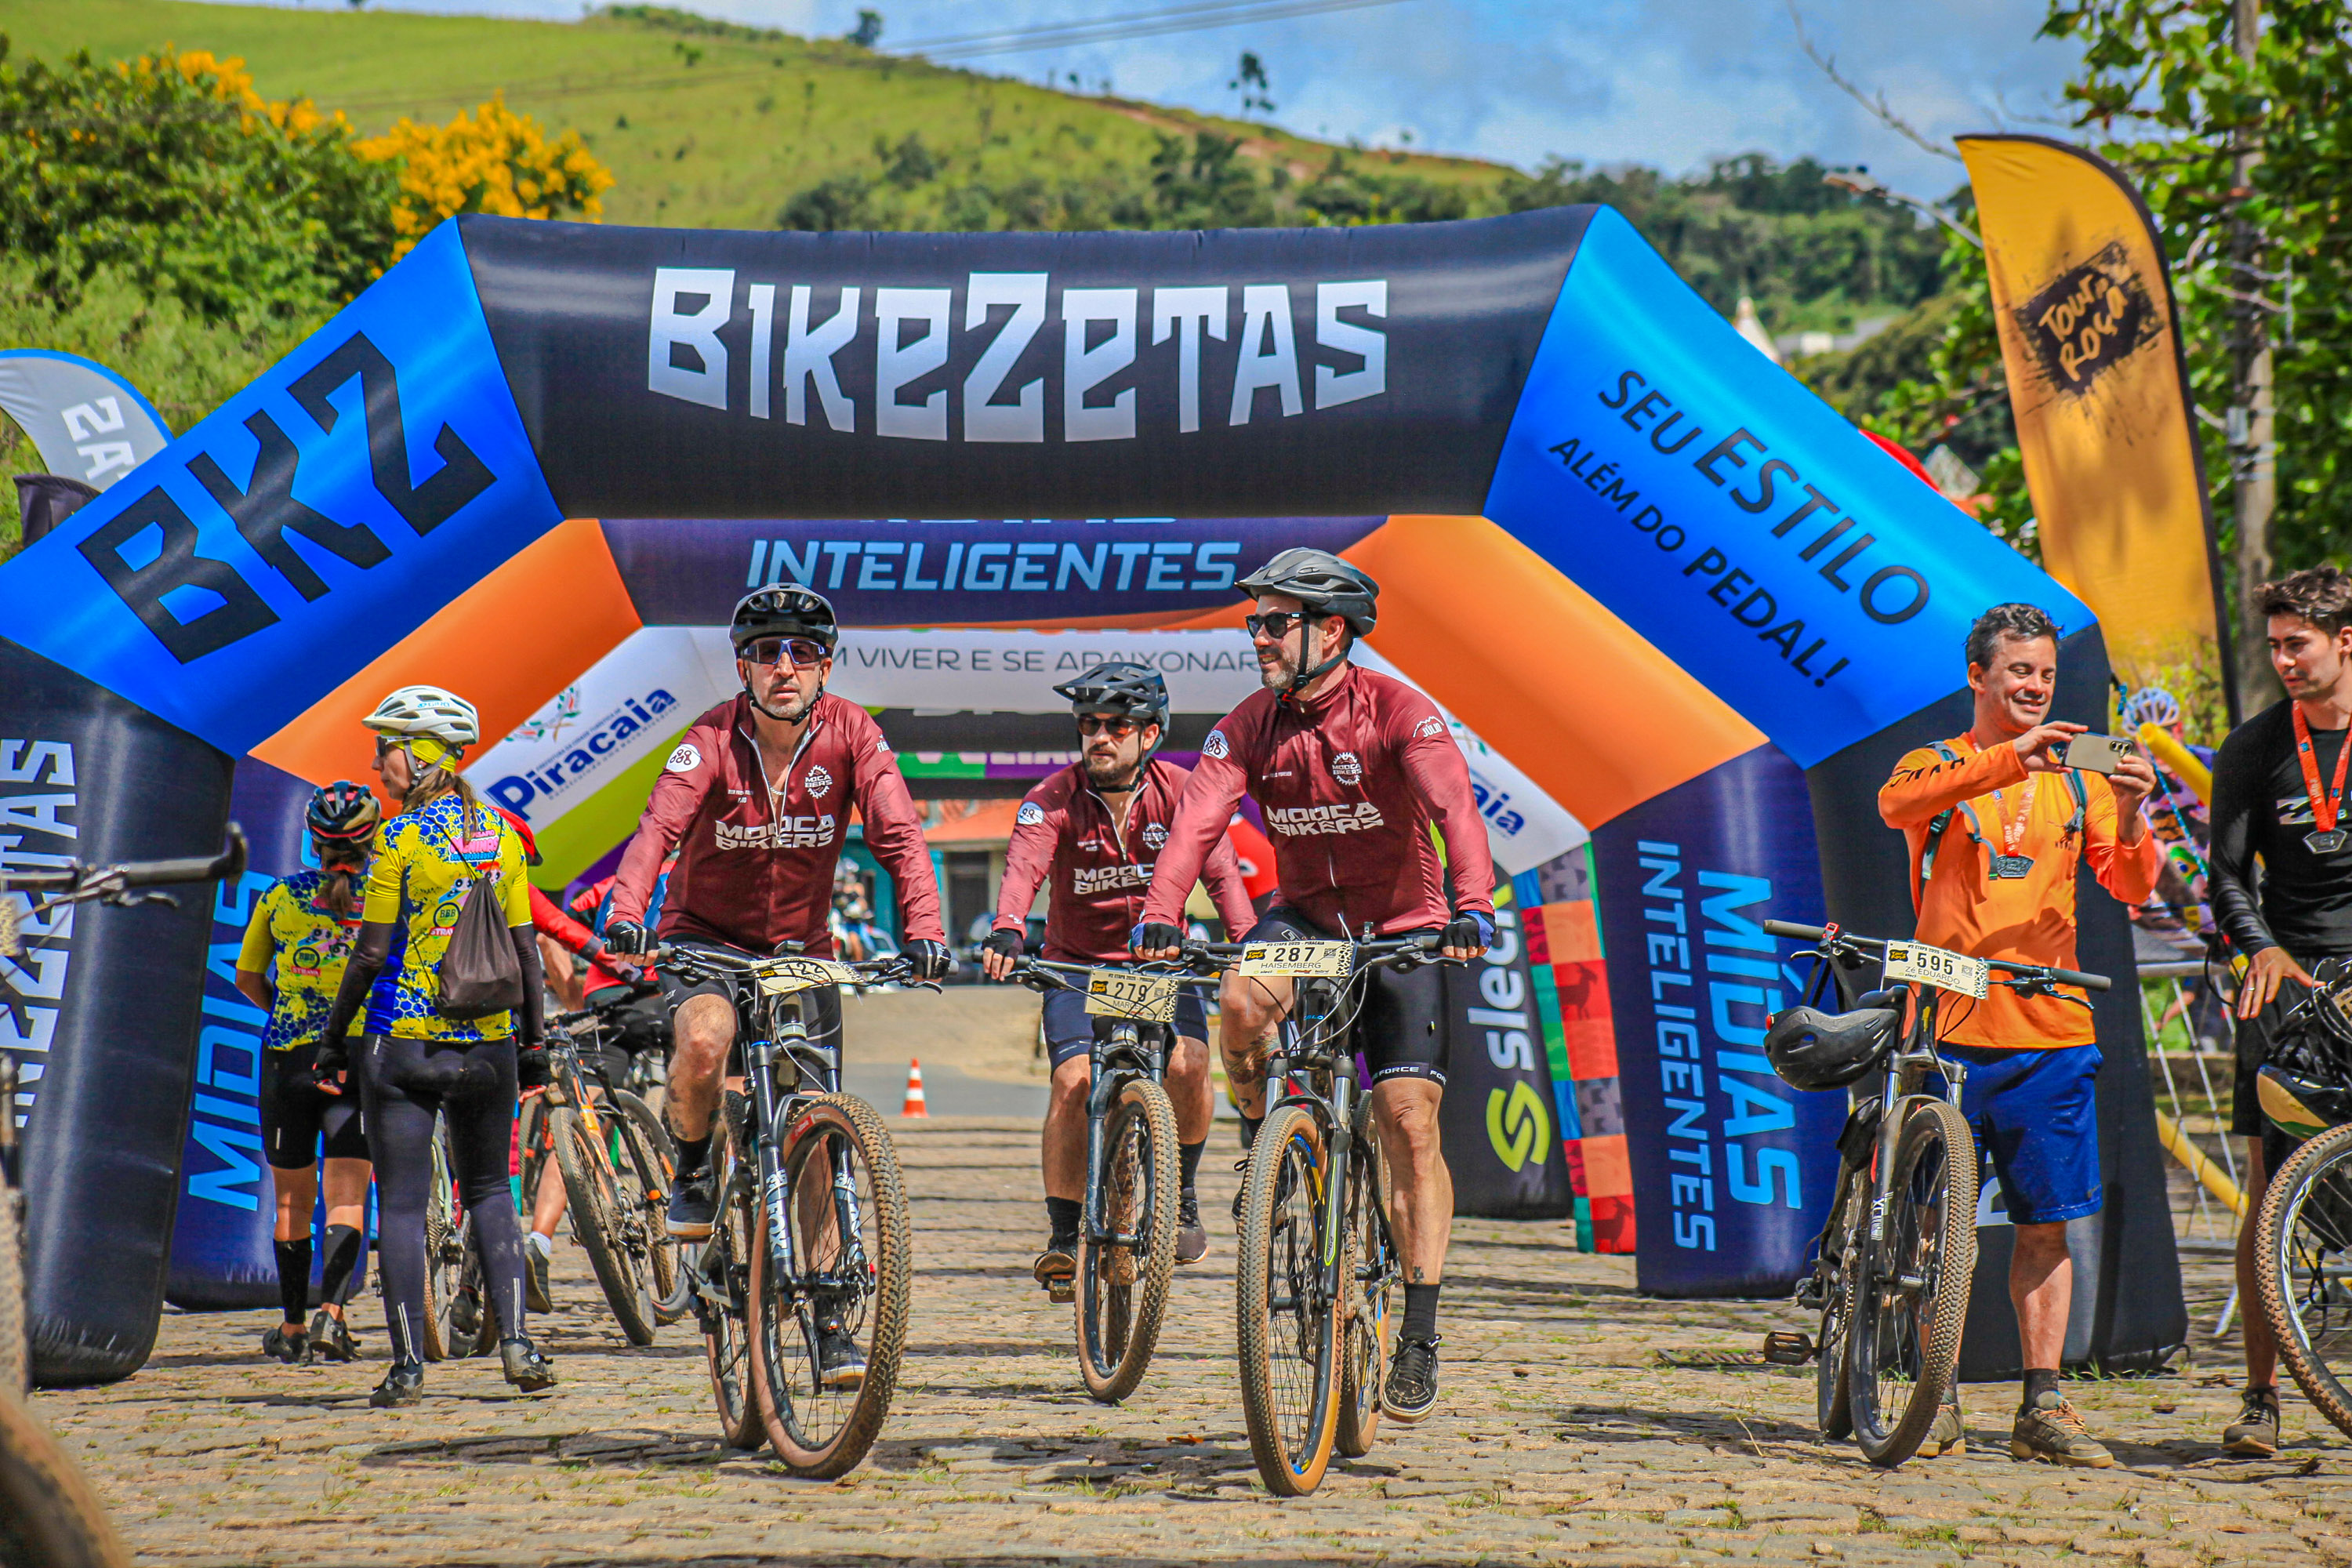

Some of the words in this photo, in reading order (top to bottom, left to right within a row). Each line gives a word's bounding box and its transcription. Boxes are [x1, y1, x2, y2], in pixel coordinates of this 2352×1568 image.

[76, 330, 498, 665] BKZ
[1597, 370, 1704, 455] SEU
[1693, 426, 1930, 625] ESTILO
[746, 539, 1241, 591] INTELIGENTES
[1549, 437, 1640, 514] ALÉM
[1630, 504, 1686, 552] DO
[1682, 546, 1851, 688] PEDAL!
[857, 647, 961, 670] VIVER
[971, 649, 992, 671] E
[1003, 650, 1045, 672] SE
[1422, 722, 1443, 738] JÚLIO
[485, 689, 677, 822] Piracaia
[1265, 801, 1379, 823] MOOCA
[715, 815, 835, 840] MOOCA
[1269, 813, 1384, 837] BIKERS
[715, 828, 835, 851] BIKERS
[1073, 863, 1155, 882] MOOC
[1073, 876, 1152, 895] BIKE
[430, 927, 454, 936] STRAV
[1273, 947, 1316, 962] 287
[1916, 952, 1954, 975] 595
[785, 962, 824, 977] 122
[1918, 967, 1961, 985] EDUARDO
[1114, 982, 1148, 1002] 279
[1637, 840, 1715, 1252] INTELIGENTES
[1698, 869, 1803, 1210] MÍDIAS
[1379, 1066, 1420, 1076] FORCE
[766, 1199, 789, 1254] FOX
[1333, 1298, 1343, 1392] CHAOYANG
